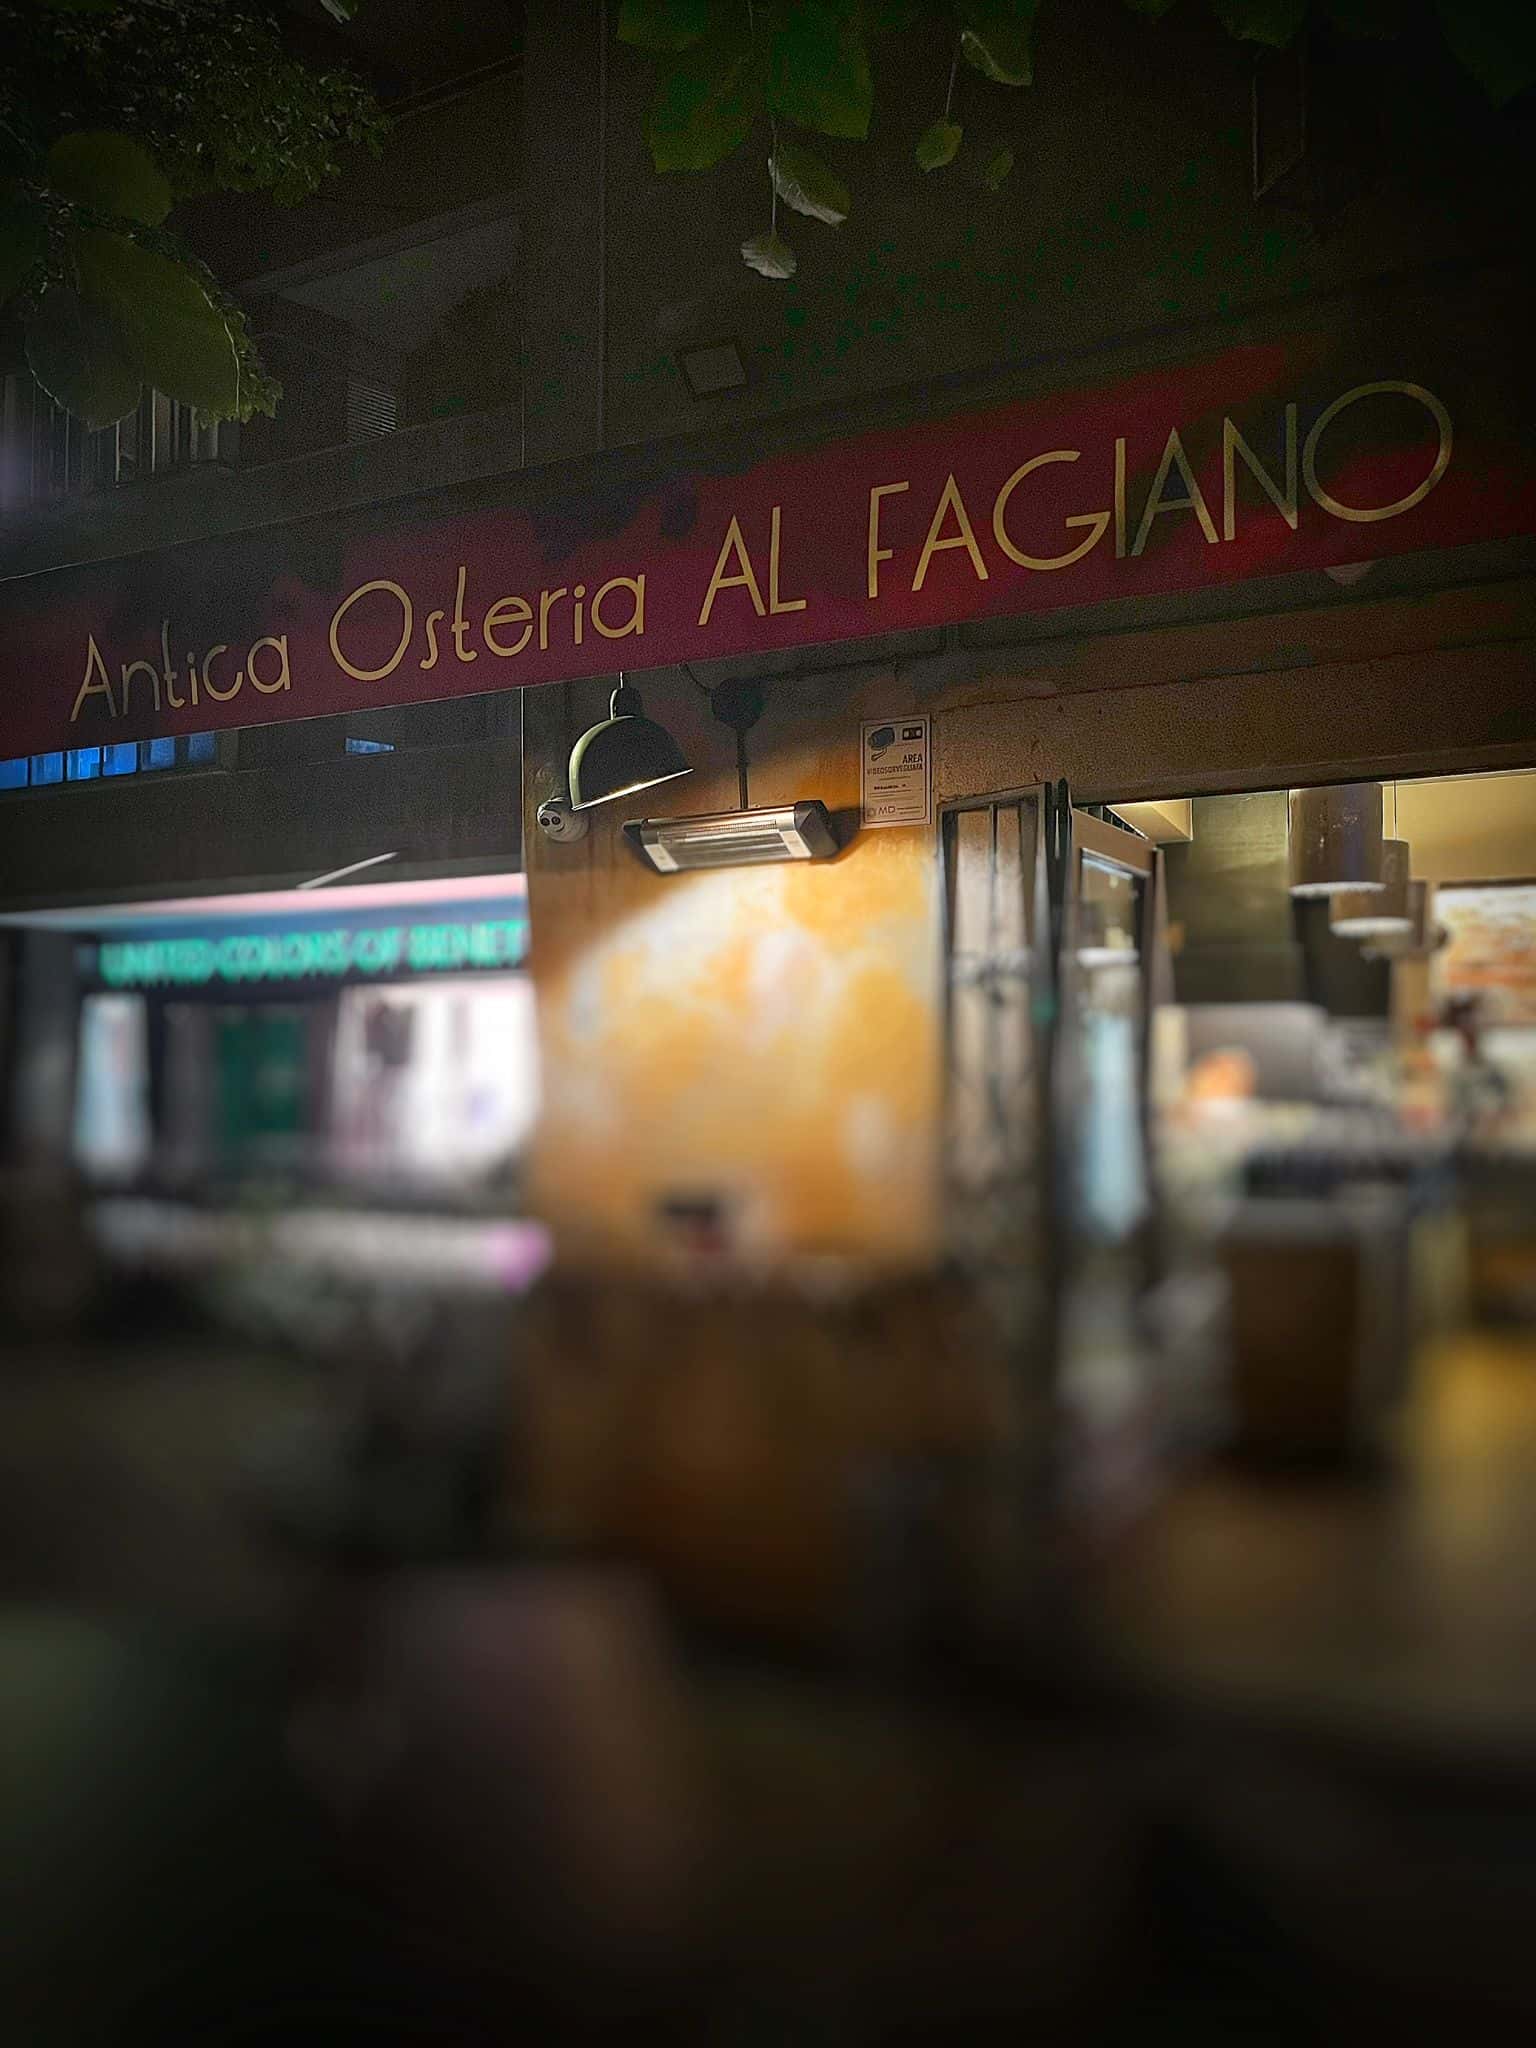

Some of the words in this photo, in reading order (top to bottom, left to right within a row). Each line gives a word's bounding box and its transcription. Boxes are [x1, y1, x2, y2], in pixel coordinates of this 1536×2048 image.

[69, 619, 292, 722] Antica
[328, 566, 646, 682] Osteria
[697, 505, 807, 626] AL
[867, 379, 1455, 599] FAGIANO
[902, 753, 923, 764] AREA
[100, 938, 214, 987] UNITED
[216, 930, 351, 983] COLORS
[353, 926, 401, 975] OF
